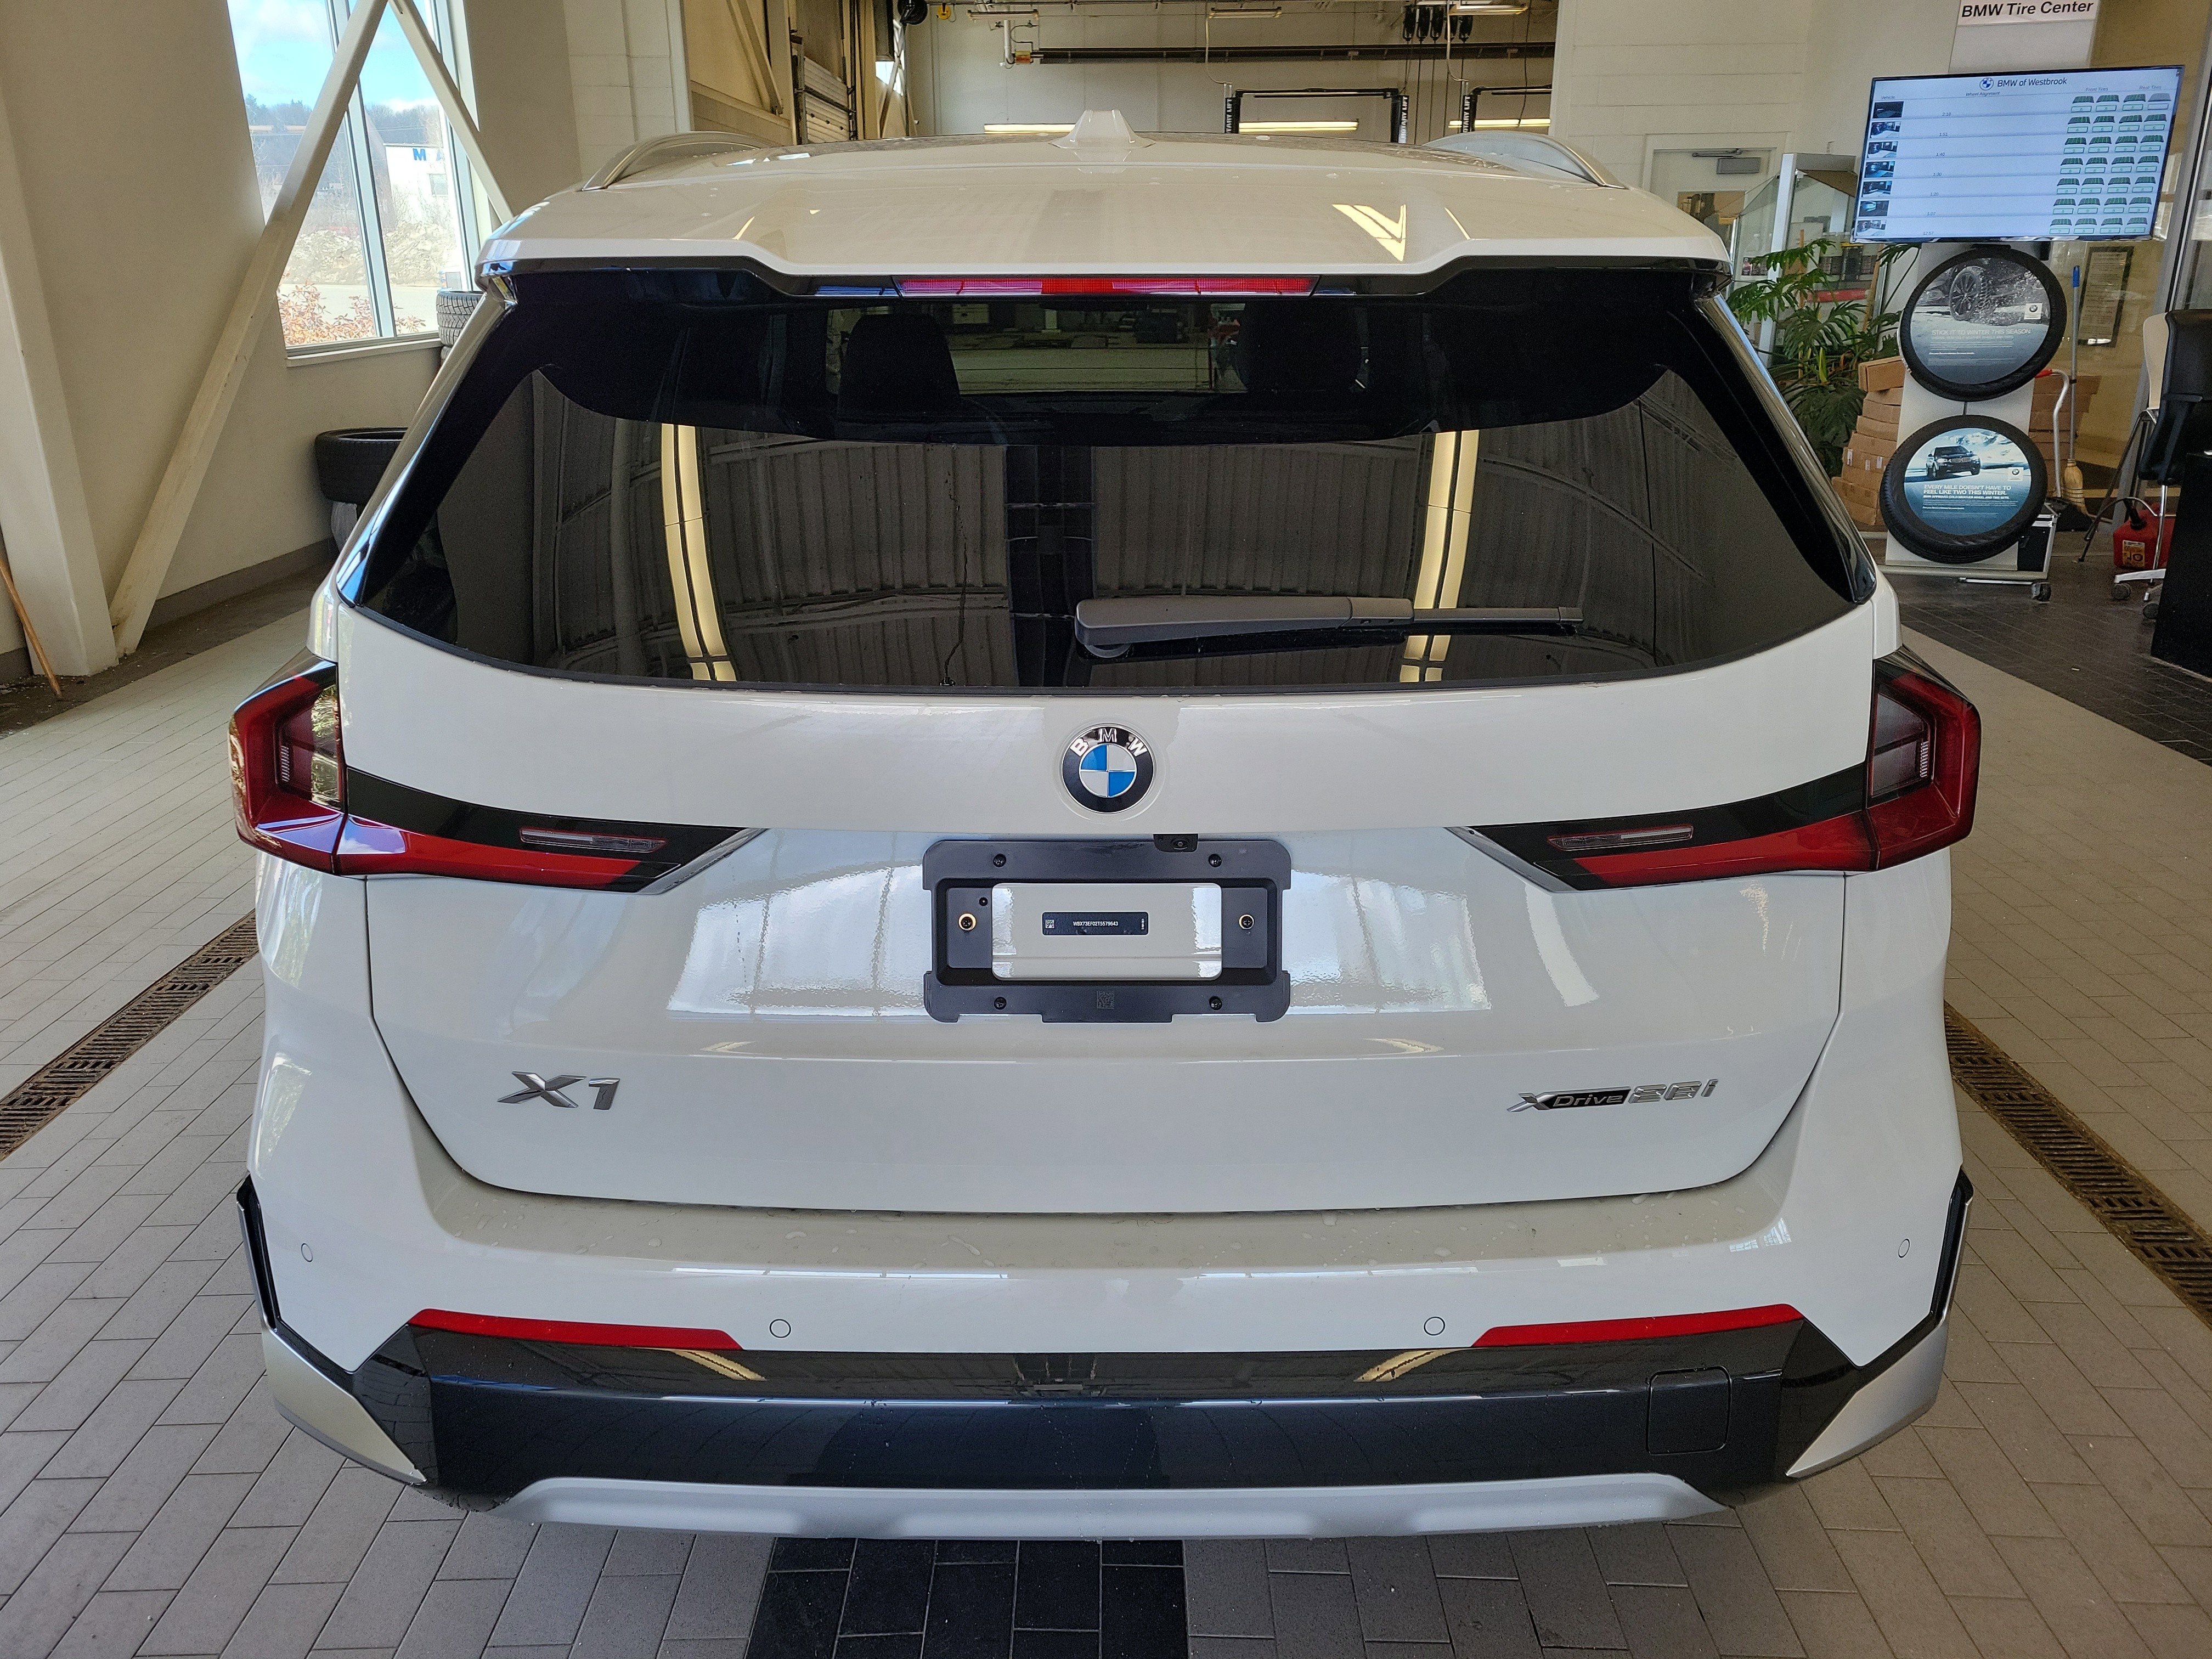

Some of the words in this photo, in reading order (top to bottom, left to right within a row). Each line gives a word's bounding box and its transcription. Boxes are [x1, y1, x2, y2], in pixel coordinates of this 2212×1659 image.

[1962, 4, 2004, 17] BMW
[2006, 3, 2036, 15] Tire
[2040, 1, 2094, 14] Center
[2028, 77, 2068, 86] Westbrook
[1070, 728, 1148, 757] BMW
[497, 1071, 620, 1110] X1
